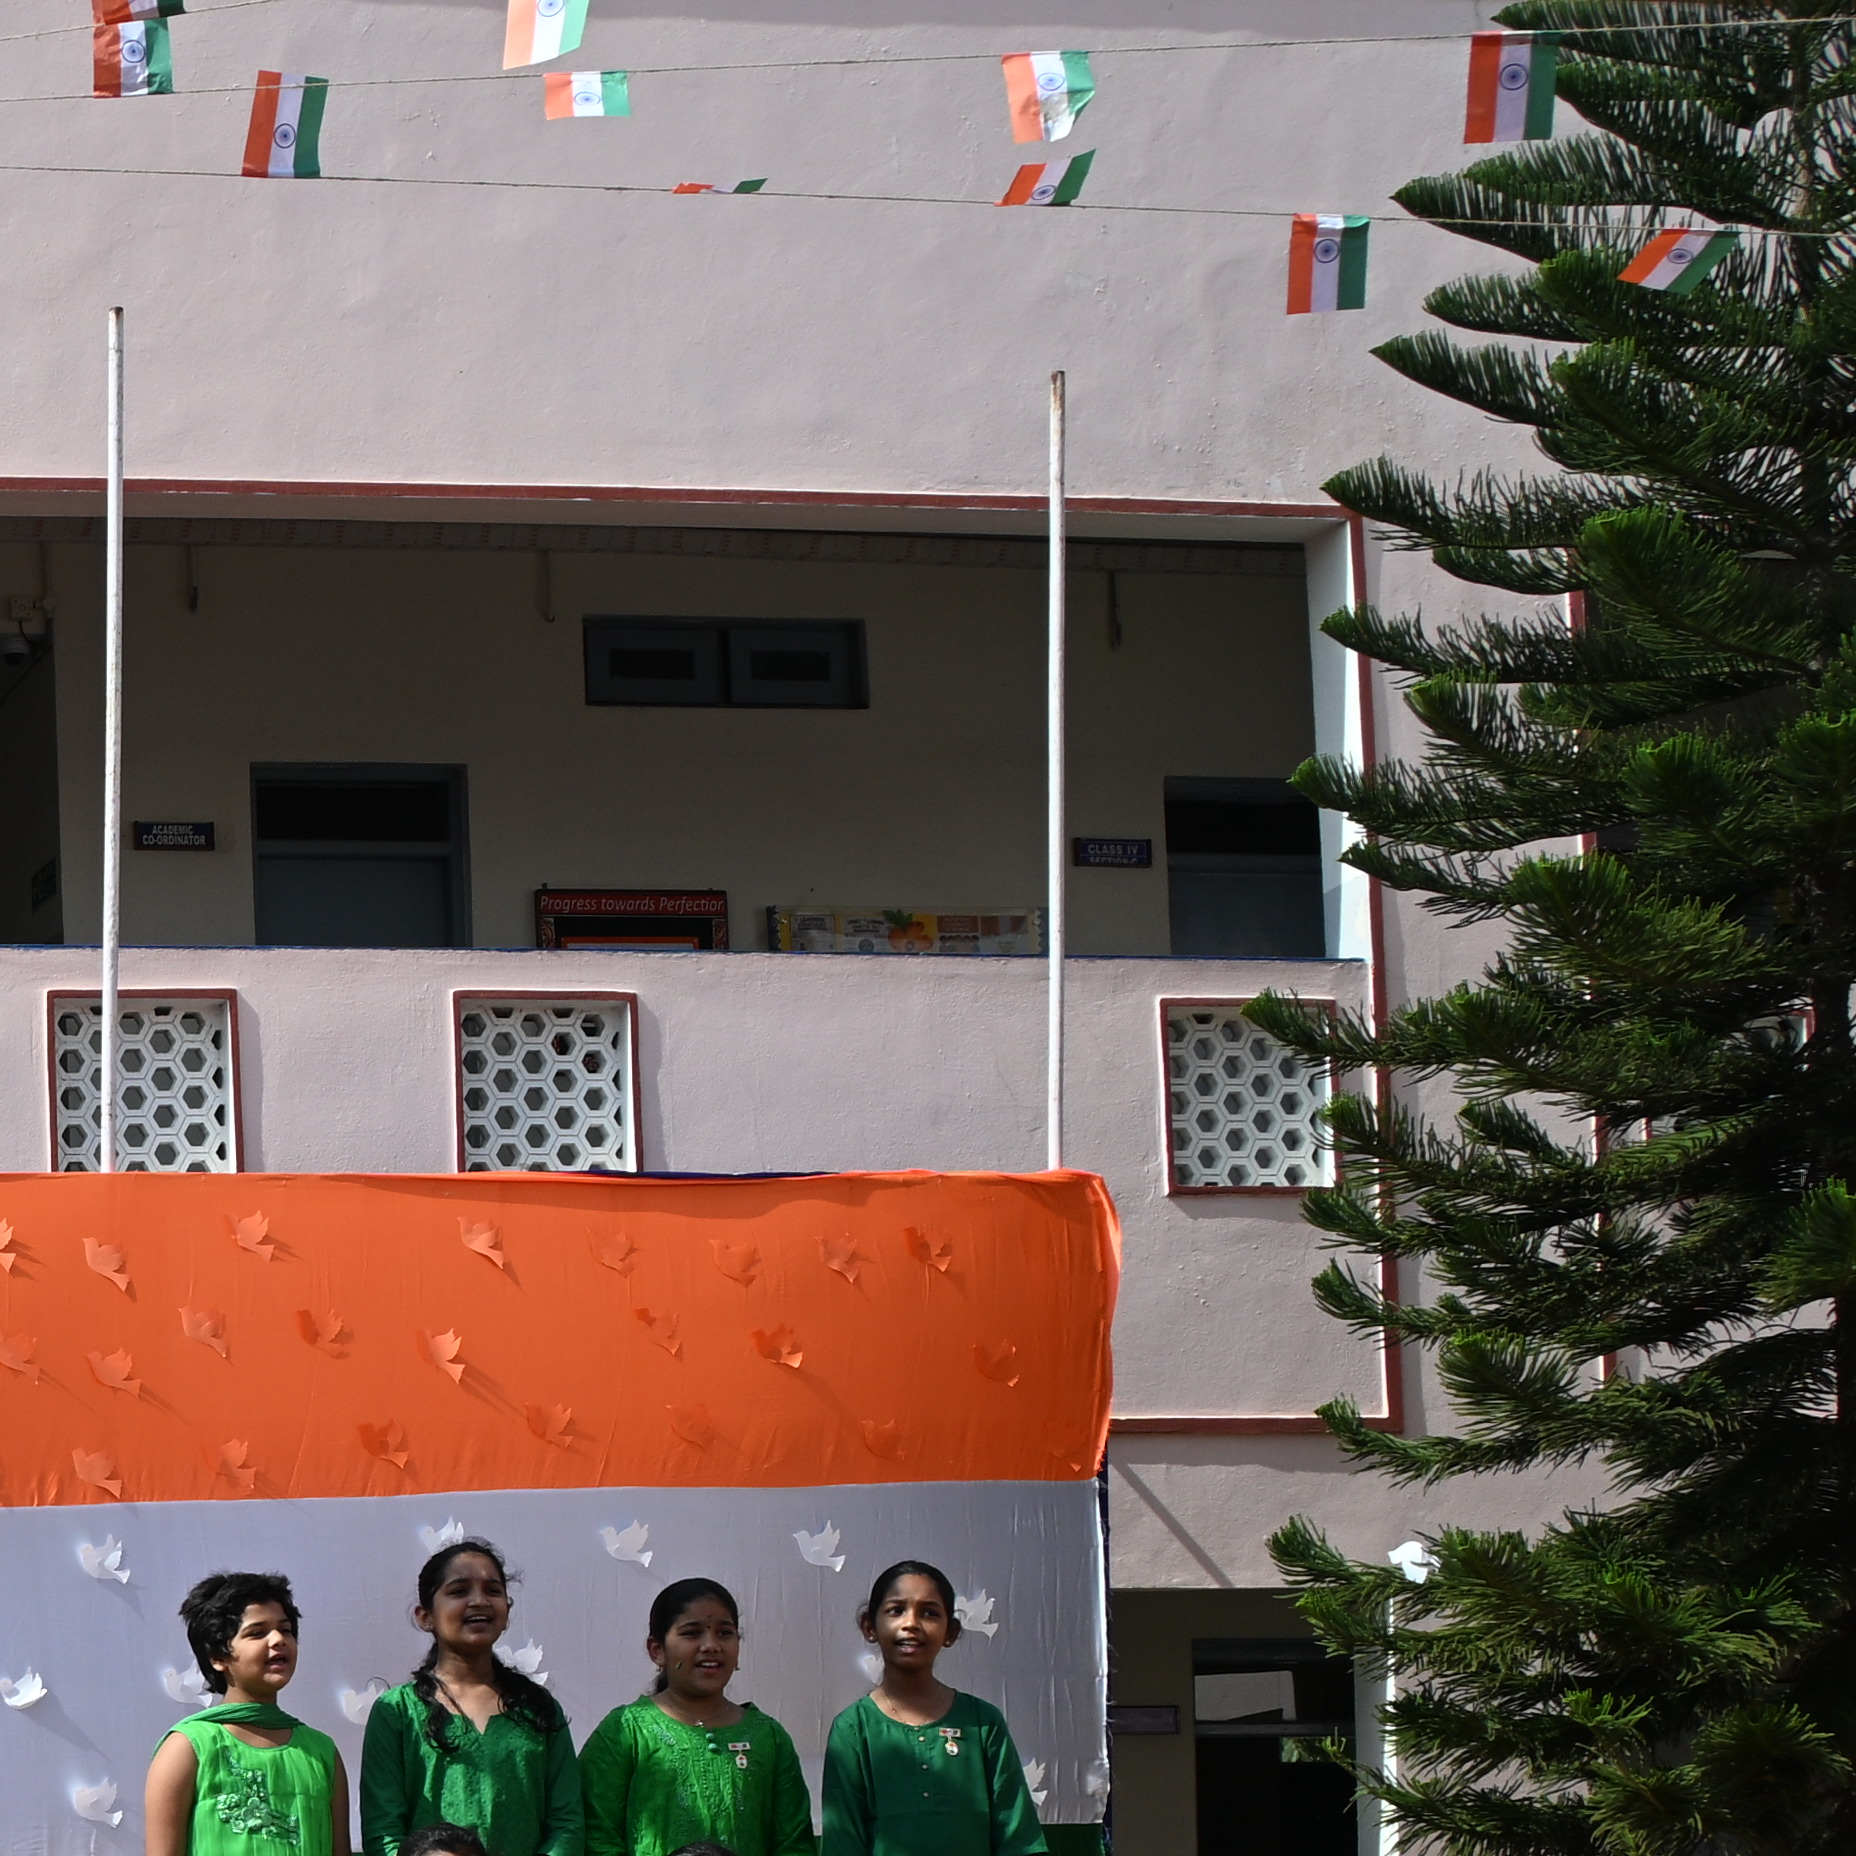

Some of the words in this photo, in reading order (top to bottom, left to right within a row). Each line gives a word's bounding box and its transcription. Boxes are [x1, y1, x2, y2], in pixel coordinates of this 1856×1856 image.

[152, 825, 194, 834] ACADEMIC
[142, 835, 206, 845] CO-ORDINATOR
[1088, 844, 1124, 855] CLASS
[540, 896, 597, 913] Progress
[601, 897, 655, 911] towards
